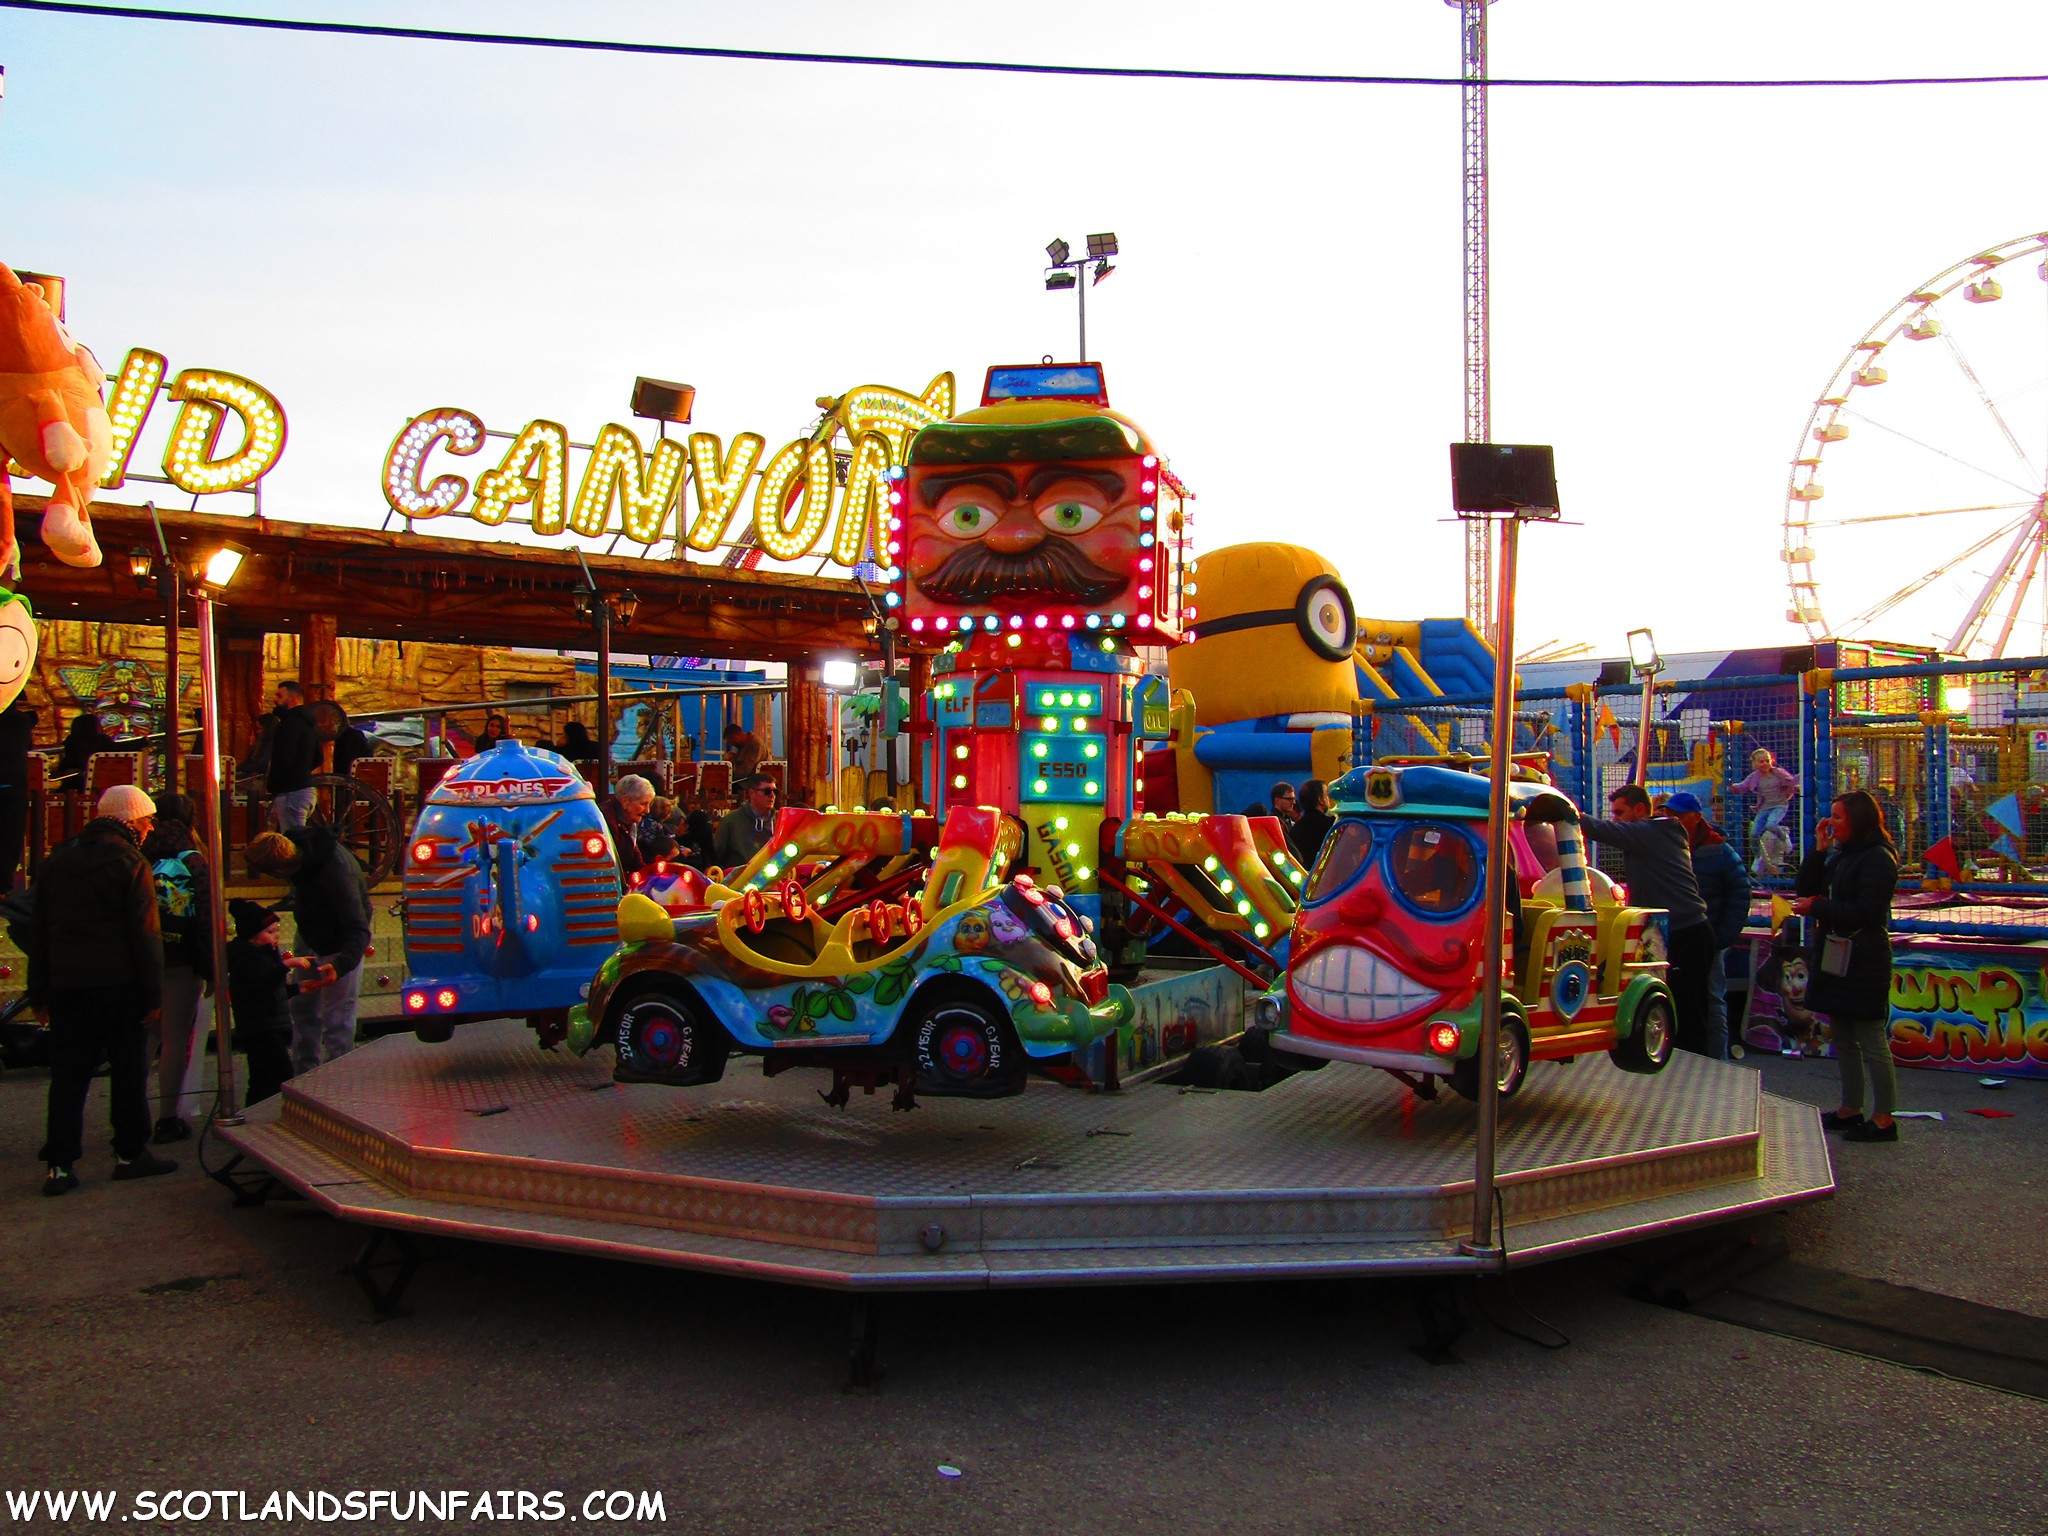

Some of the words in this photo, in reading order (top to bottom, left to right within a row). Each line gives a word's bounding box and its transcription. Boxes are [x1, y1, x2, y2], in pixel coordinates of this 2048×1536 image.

[945, 696, 971, 713] ELF
[1145, 712, 1166, 729] OIL
[1038, 761, 1088, 779] ESSO
[473, 782, 545, 797] PLANES
[1889, 970, 2024, 1025] ump
[618, 1013, 635, 1060] 22/150R
[918, 1020, 937, 1069] 22/150R
[985, 1025, 1001, 1068] G.YEAR
